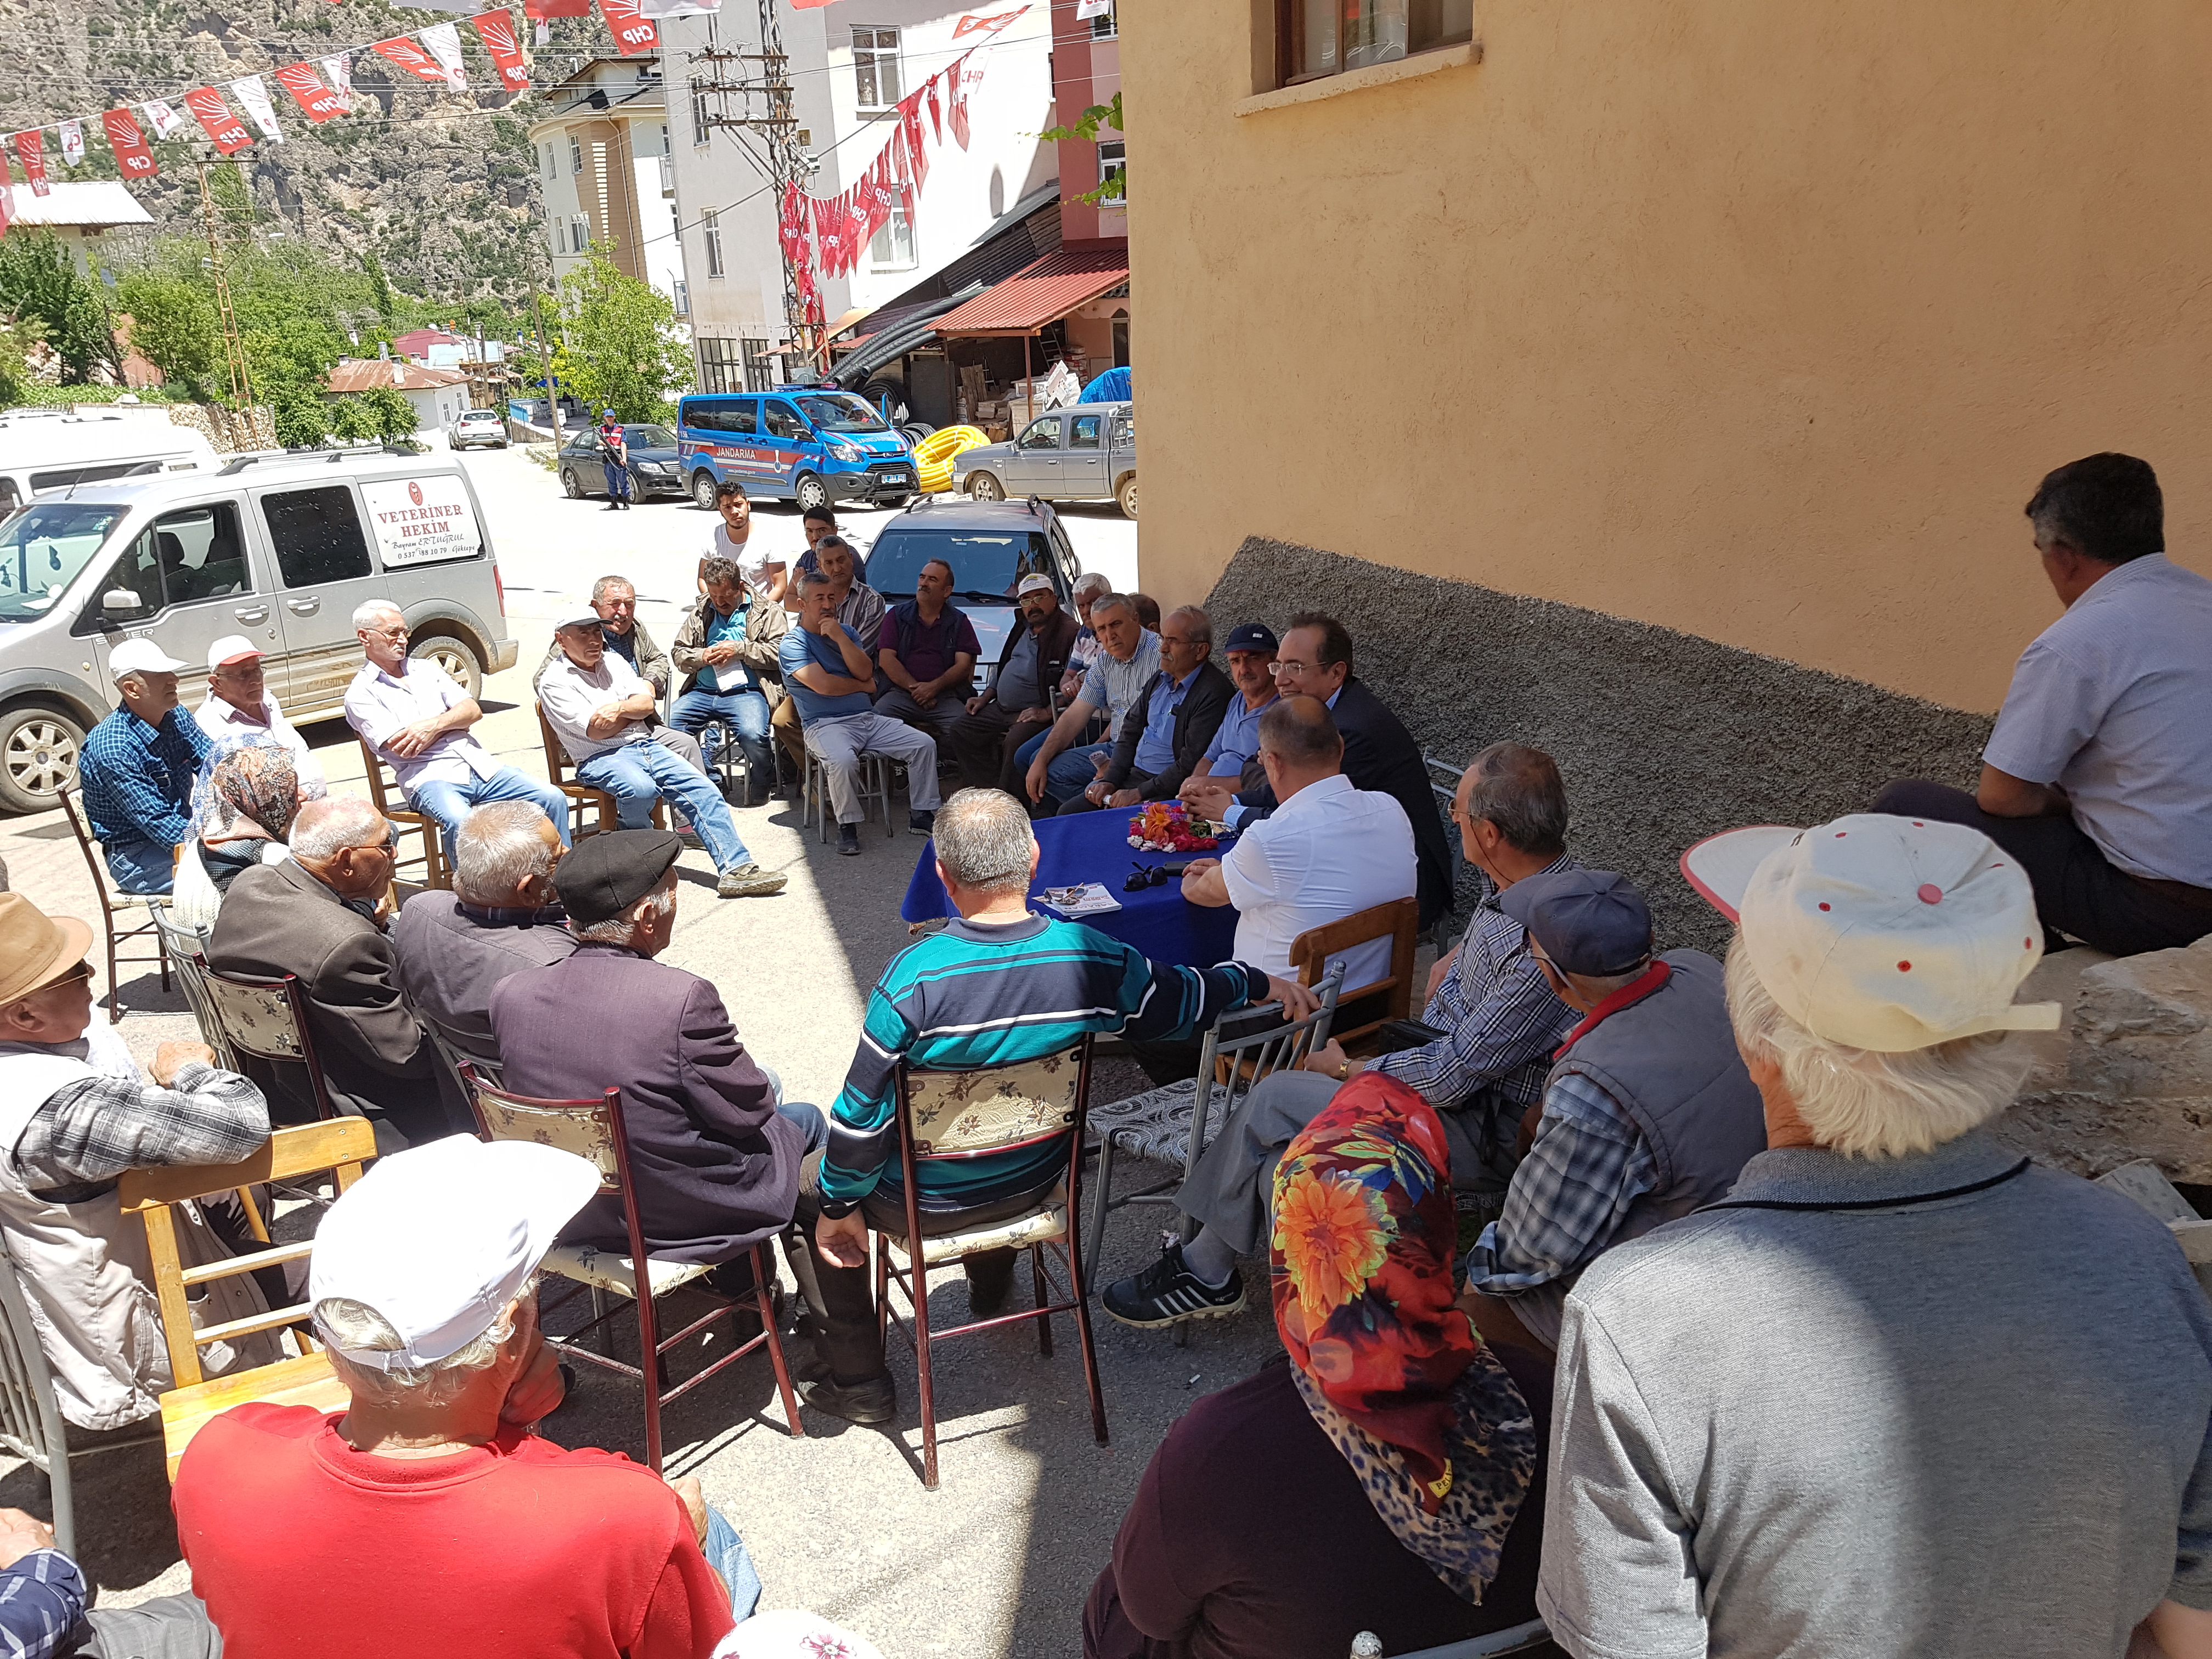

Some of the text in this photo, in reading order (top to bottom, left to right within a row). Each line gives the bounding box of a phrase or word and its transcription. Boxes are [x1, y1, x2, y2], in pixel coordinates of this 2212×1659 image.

[962, 70, 984, 83] CHP
[716, 447, 756, 460] JANDARMA
[377, 504, 463, 523] VETERİNER
[400, 520, 450, 537] HEKİM
[419, 533, 464, 546] ERTUĞRUL
[95, 629, 154, 645] SILVER
